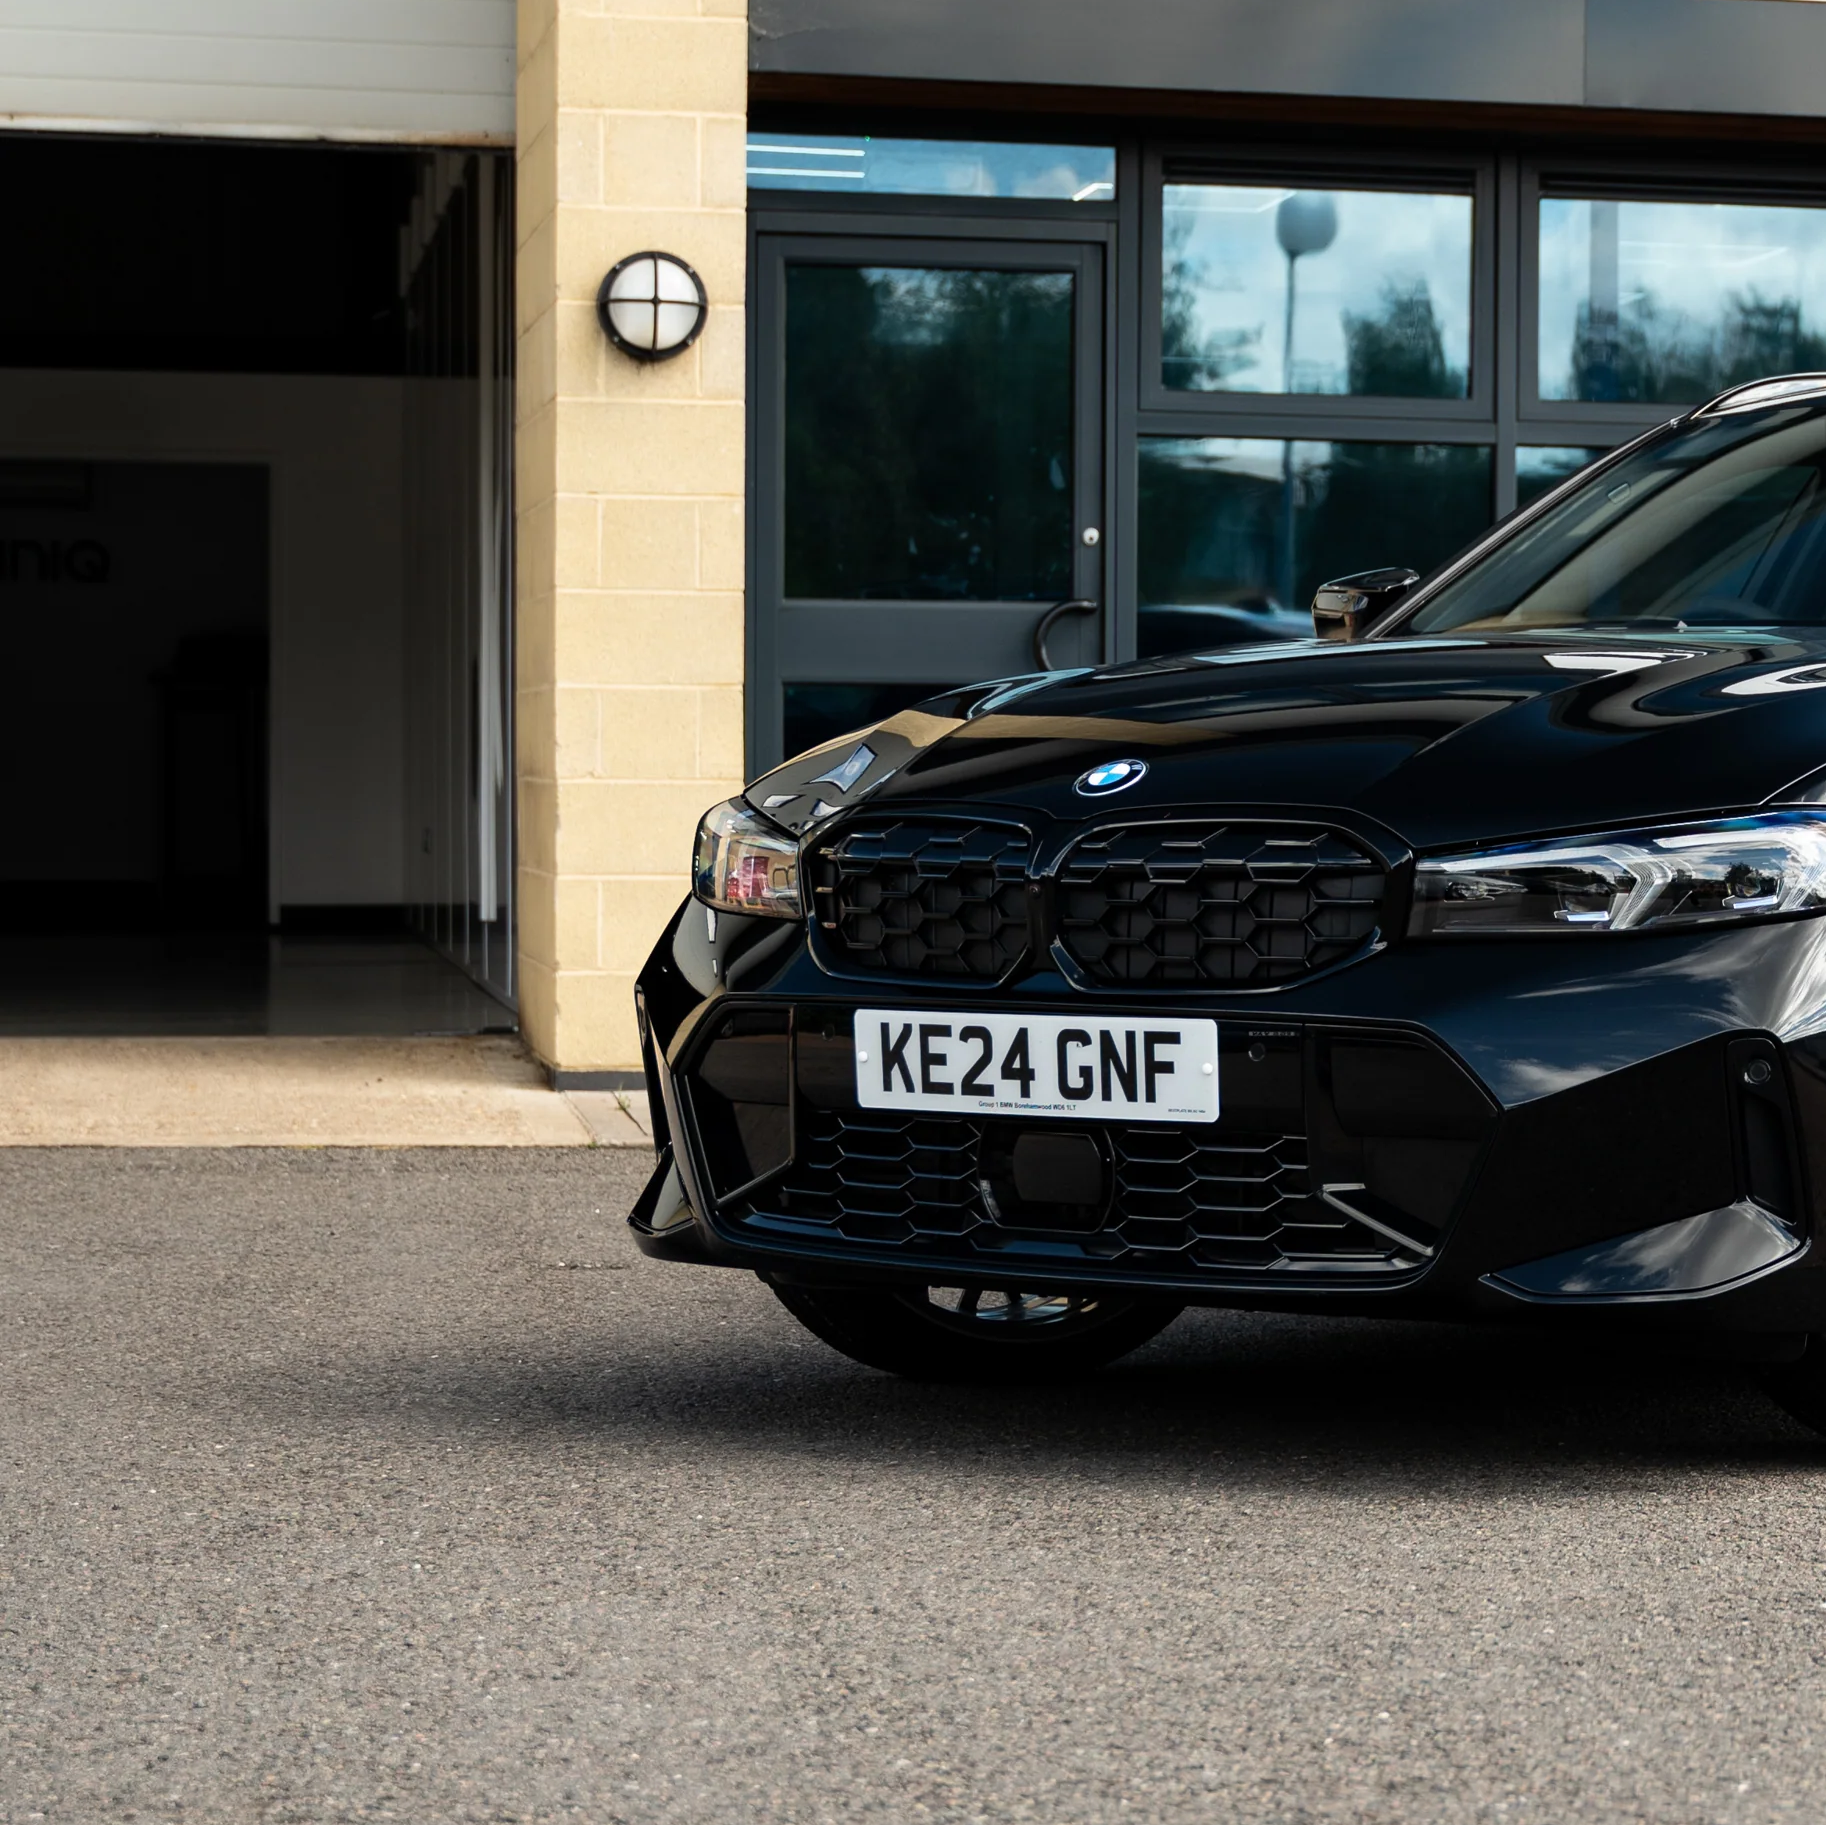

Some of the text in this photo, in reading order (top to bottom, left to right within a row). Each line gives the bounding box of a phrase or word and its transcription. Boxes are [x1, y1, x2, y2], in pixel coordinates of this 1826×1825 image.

[880, 1022, 1181, 1104] KE24 GNF
[978, 1100, 995, 1109] Group
[1000, 1101, 1013, 1109] BMW
